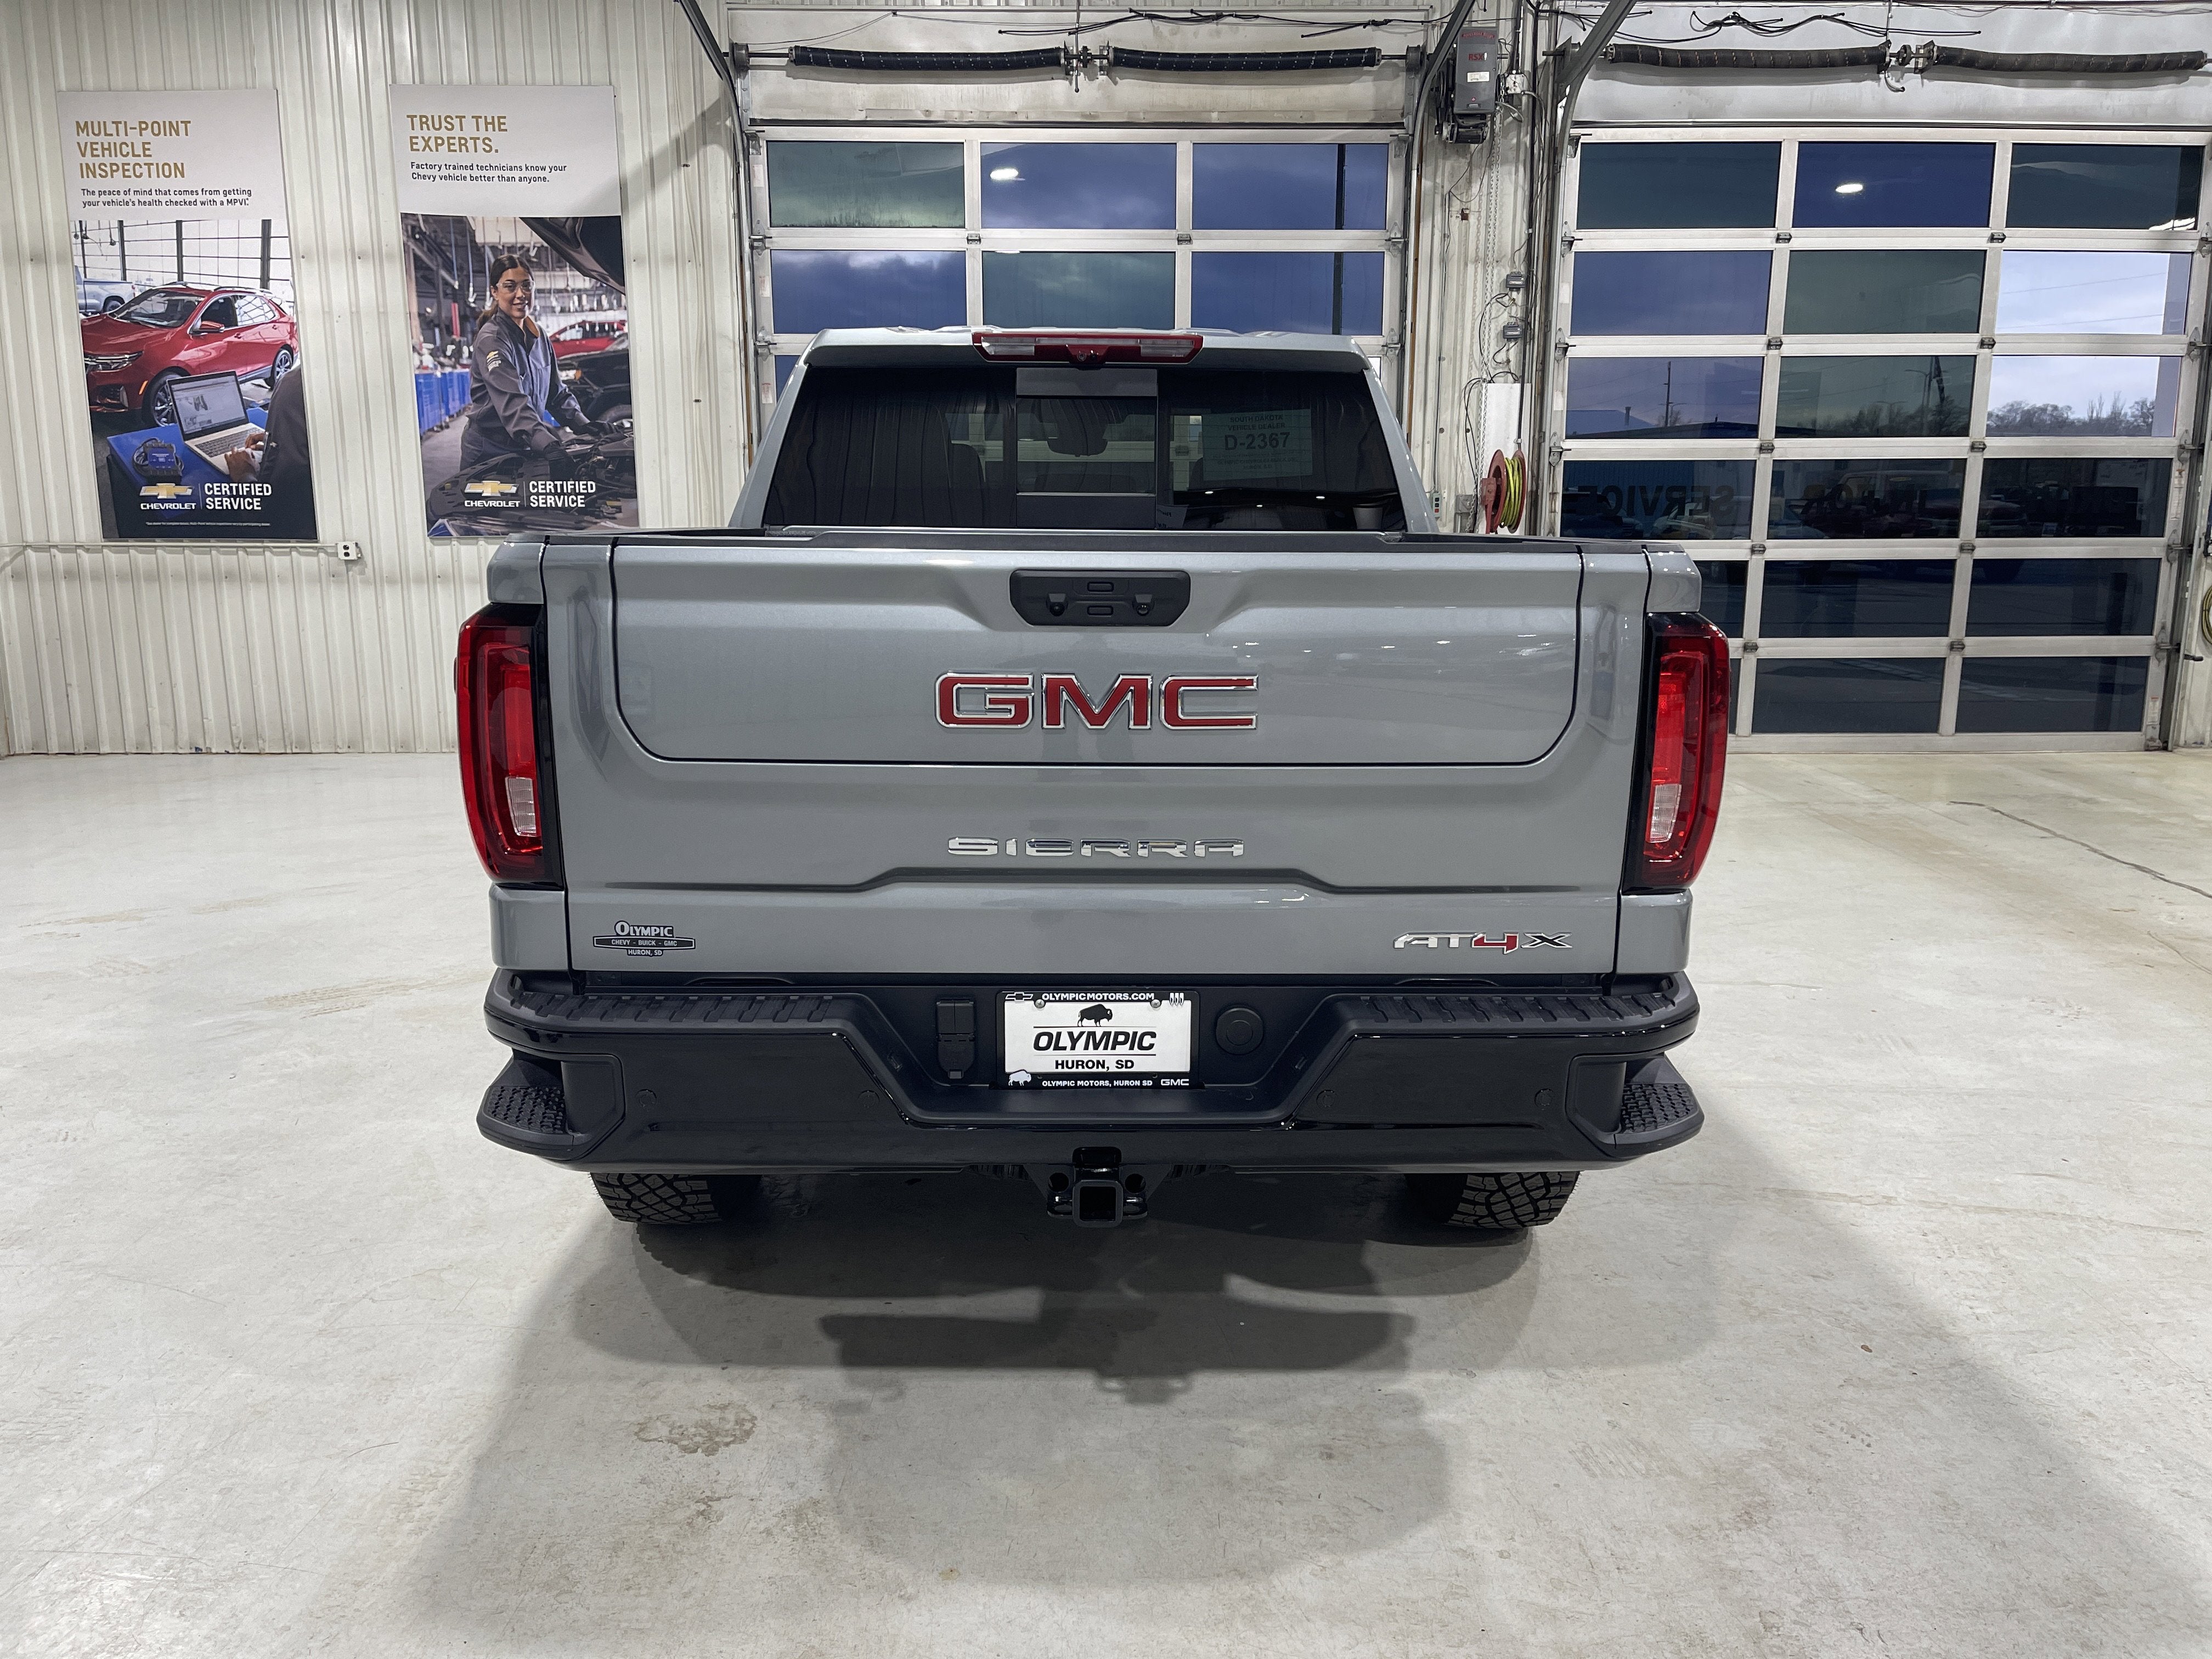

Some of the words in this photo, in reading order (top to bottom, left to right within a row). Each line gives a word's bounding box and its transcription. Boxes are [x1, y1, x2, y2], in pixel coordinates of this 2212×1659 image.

[75, 120, 191, 137] MULTI-POINT
[407, 115, 466, 132] TRUST
[471, 115, 508, 132] THE
[77, 142, 152, 157] VEHICLE
[409, 136, 499, 153] EXPERTS.
[80, 162, 185, 178] INSPECTION
[411, 162, 442, 171] Factory
[411, 172, 437, 182] Chevy
[470, 174, 495, 182] better
[98, 190, 121, 198] peace
[223, 188, 252, 198] getting
[82, 200, 100, 208] your
[1224, 432, 1291, 451] D-2367
[205, 483, 272, 496] CERTIFIED
[529, 481, 596, 494] CERTIFIED
[206, 498, 262, 510] SERVICE
[530, 495, 585, 507] SERVICE
[935, 670, 1259, 730] GMC
[948, 837, 1244, 857] SIERRA
[1393, 932, 1573, 955] AT4X
[1033, 1031, 1156, 1051] OLYMPIC
[1055, 1059, 1109, 1071] HURON,
[1115, 1059, 1134, 1070] SD
